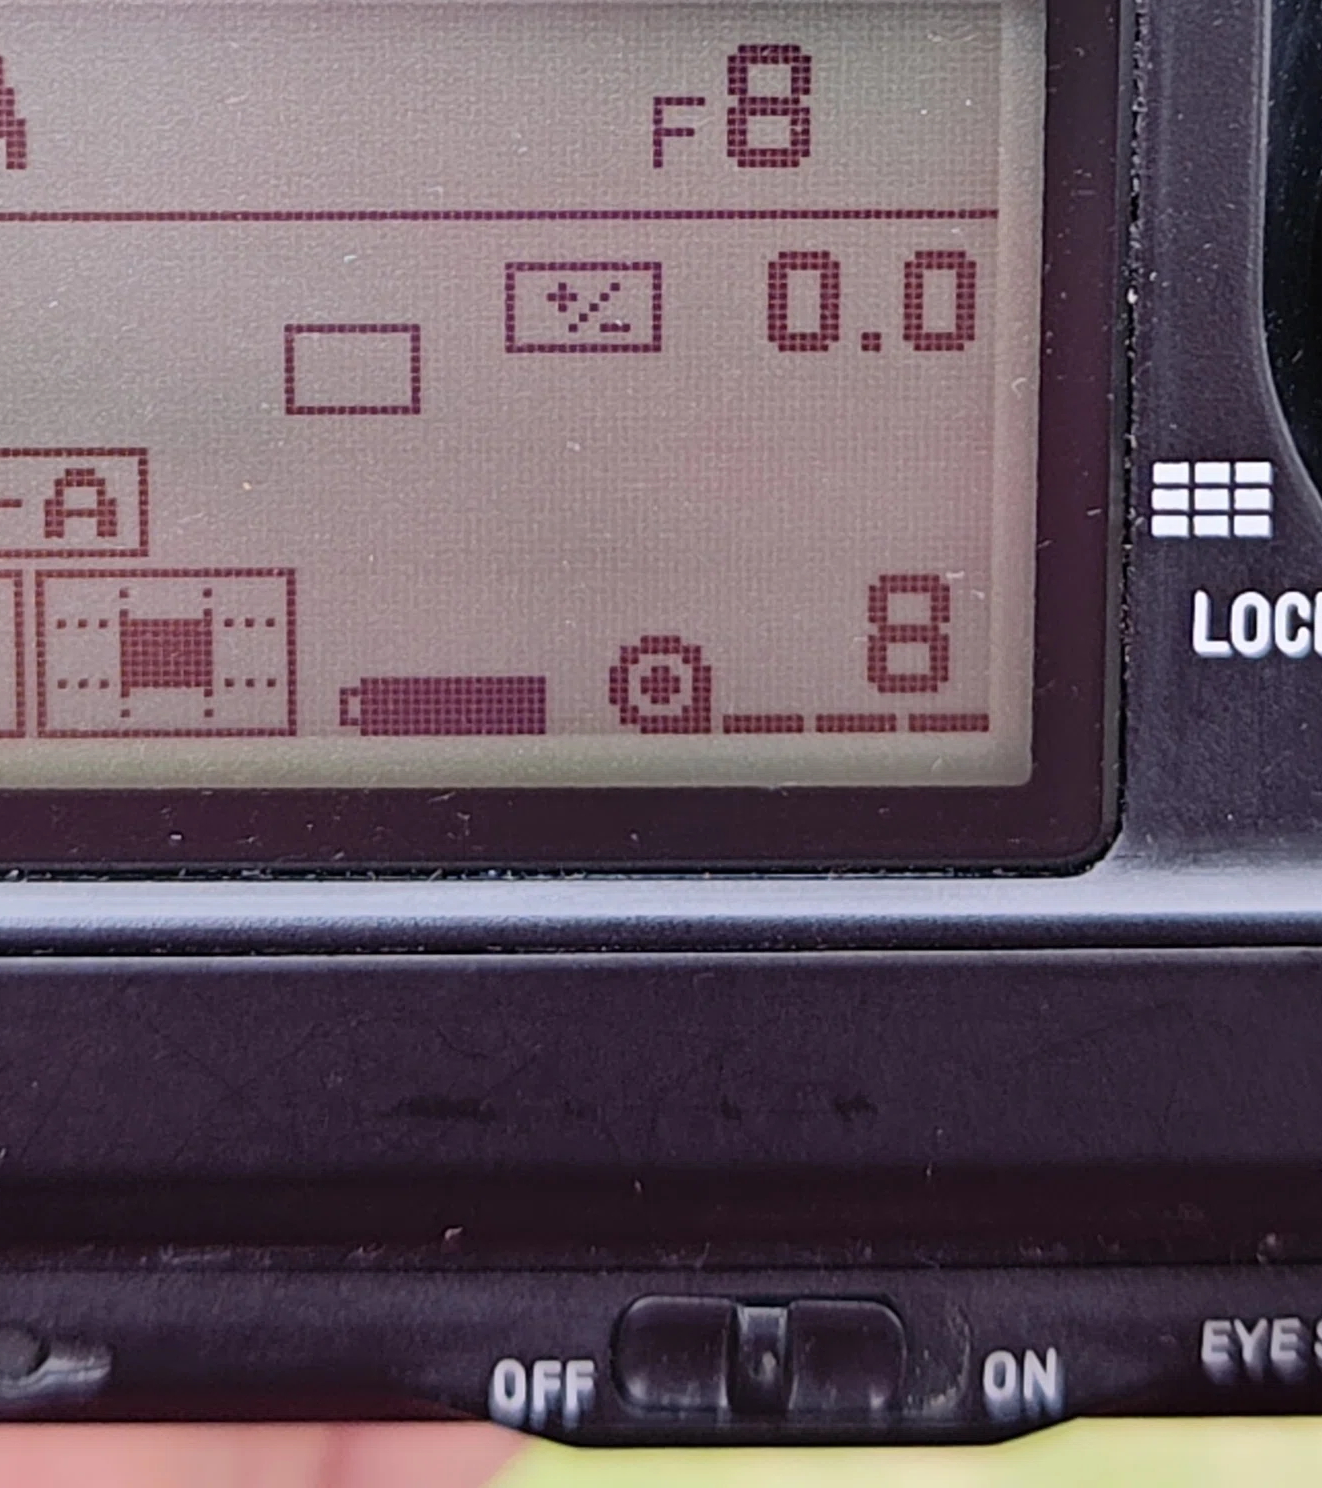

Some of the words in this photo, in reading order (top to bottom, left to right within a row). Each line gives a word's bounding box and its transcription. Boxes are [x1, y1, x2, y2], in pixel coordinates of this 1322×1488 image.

[767, 250, 977, 353] 0.0
[867, 574, 950, 694] 8
[490, 1358, 595, 1422] OFF
[982, 1347, 1065, 1412] ON
[1201, 1317, 1302, 1378] EYE
